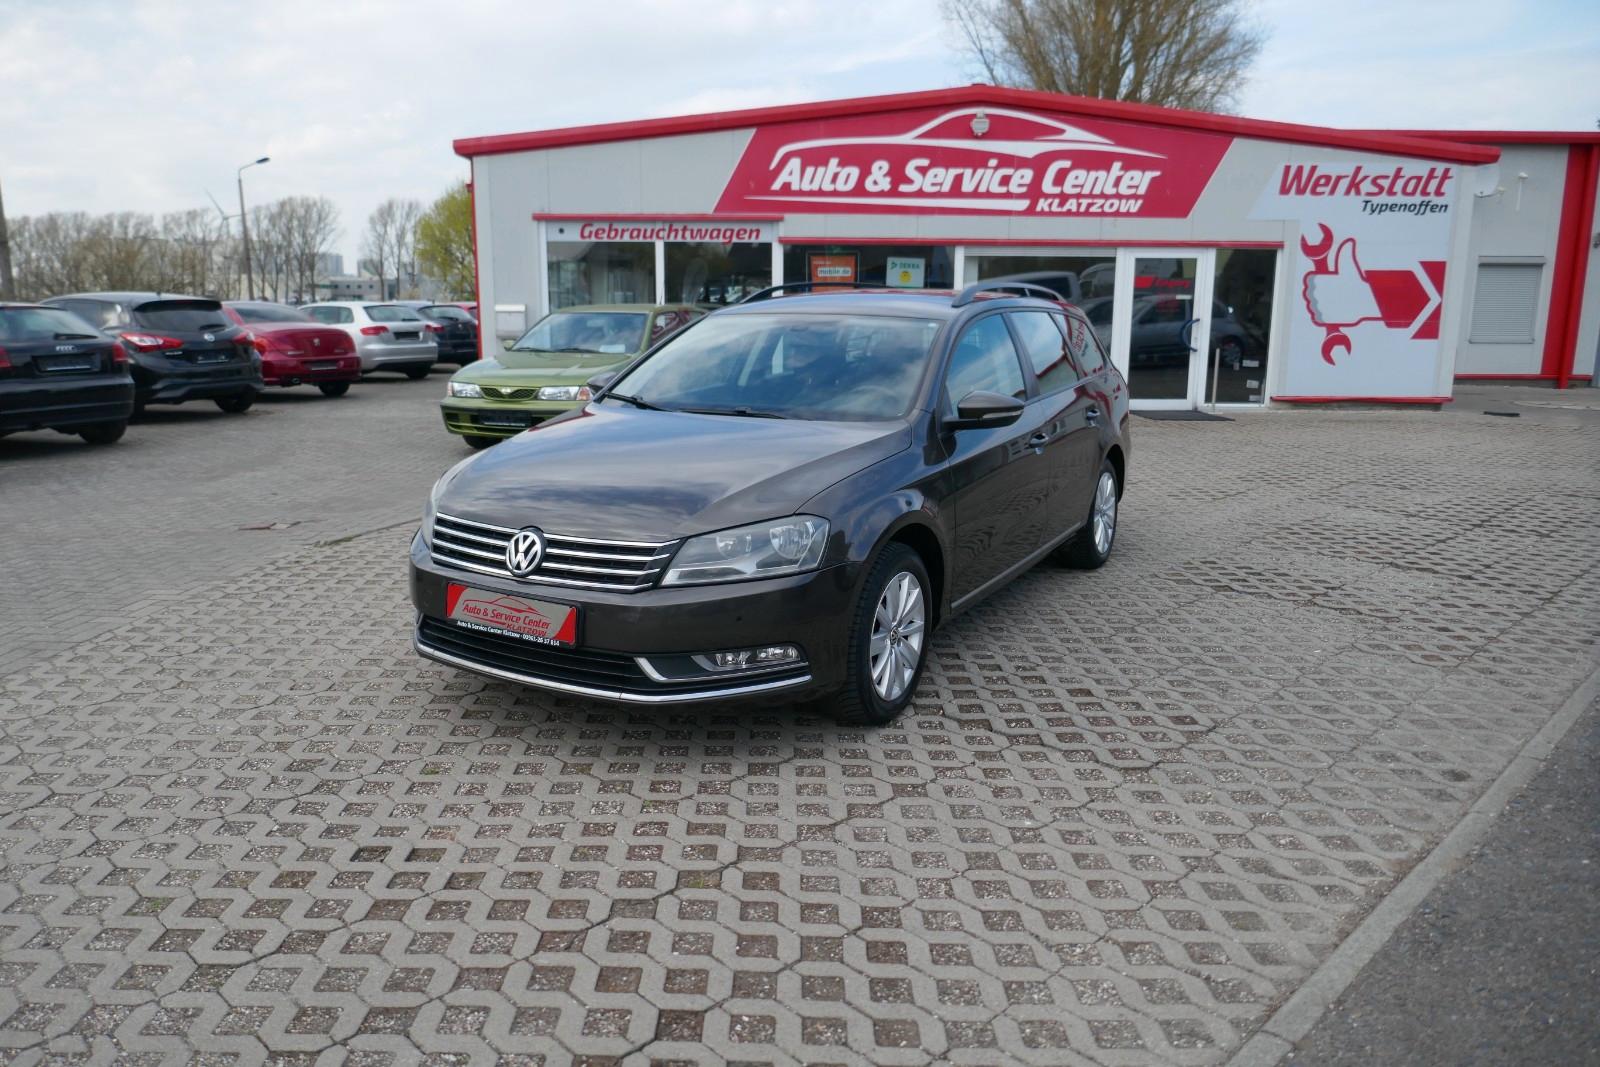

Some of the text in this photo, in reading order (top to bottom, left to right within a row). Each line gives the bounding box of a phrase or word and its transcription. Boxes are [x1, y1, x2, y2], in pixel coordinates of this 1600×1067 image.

[770, 157, 1161, 195] Auto & Service Center
[1279, 164, 1455, 197] Werkstatt
[1035, 198, 1143, 213] KLATZOW
[1361, 200, 1449, 216] Typenoffen
[579, 223, 761, 244] Gebrauchtwagen
[463, 604, 551, 629] Auto & Service Center
[472, 623, 487, 631] Service
[506, 623, 548, 636] KLATZOW
